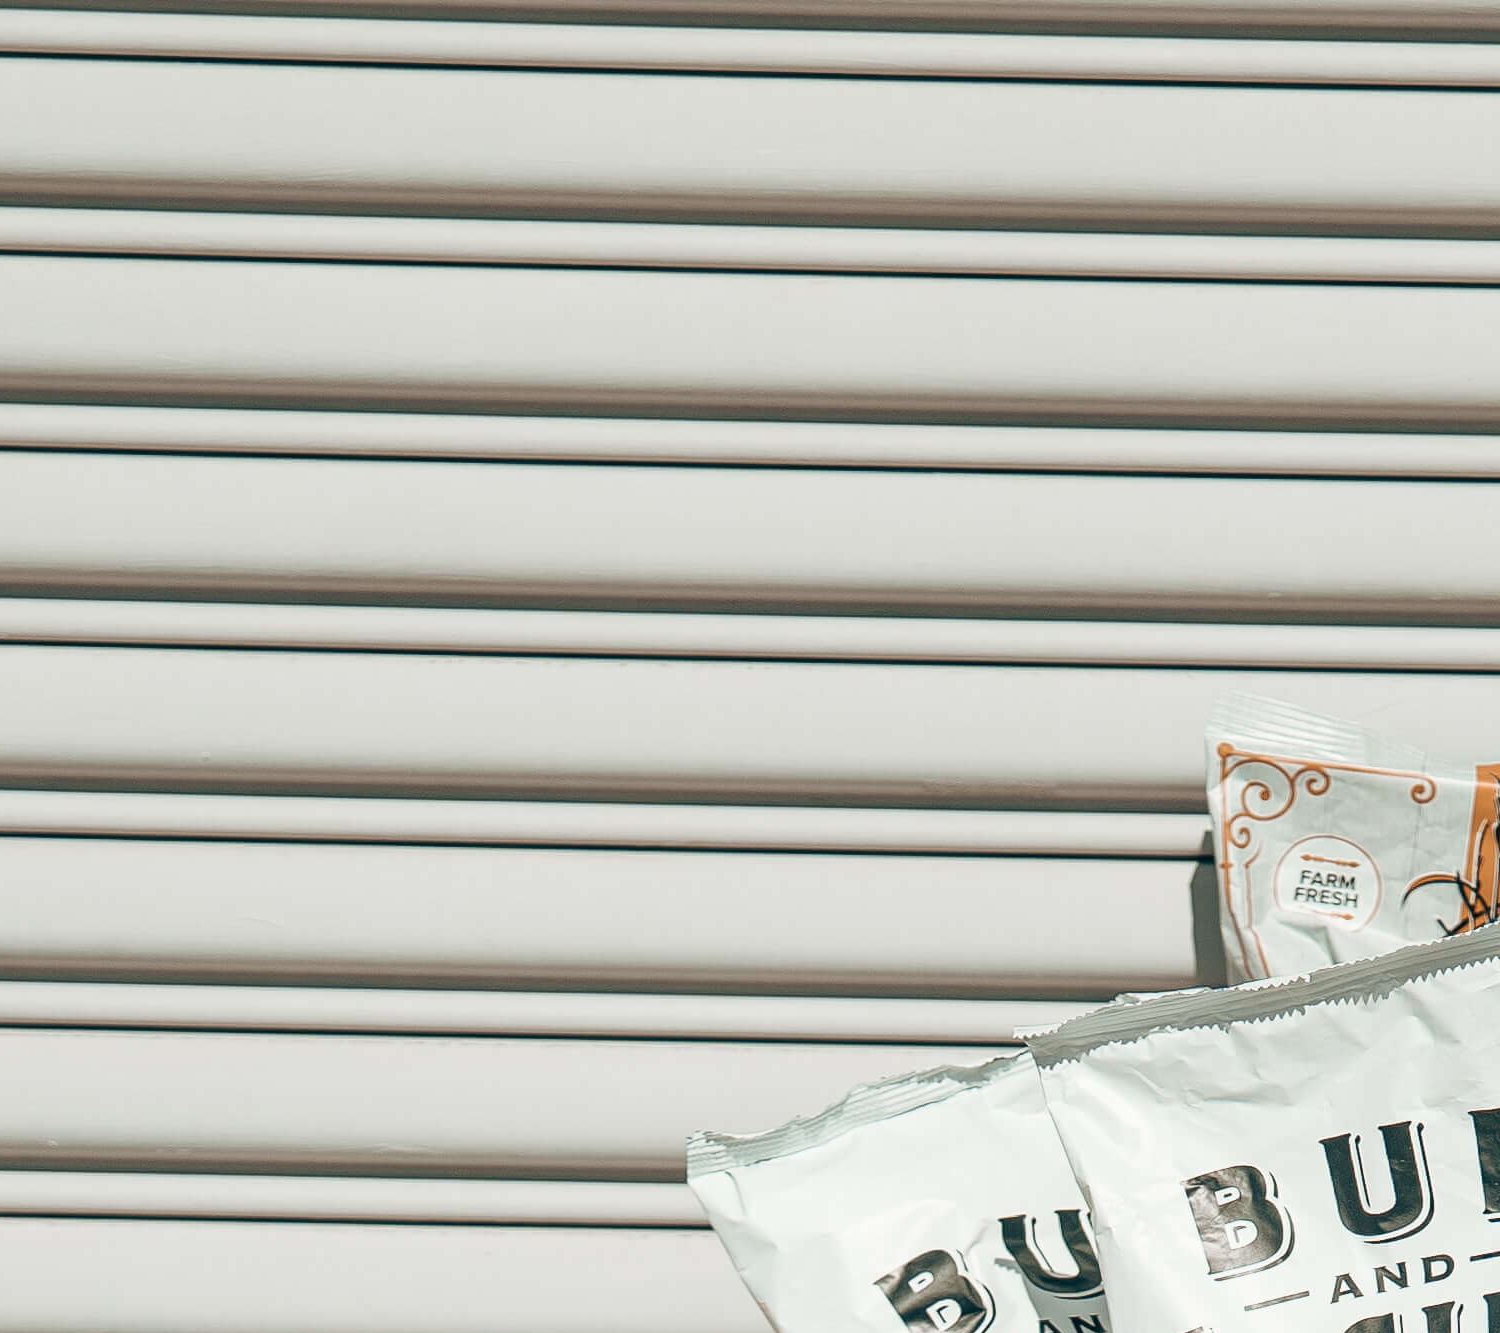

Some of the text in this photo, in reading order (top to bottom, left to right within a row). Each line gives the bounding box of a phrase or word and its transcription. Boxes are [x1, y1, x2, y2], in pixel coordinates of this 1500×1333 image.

[1301, 868, 1357, 890] FARM
[1293, 886, 1359, 910] FRESH
[1330, 1253, 1456, 1304] AND
